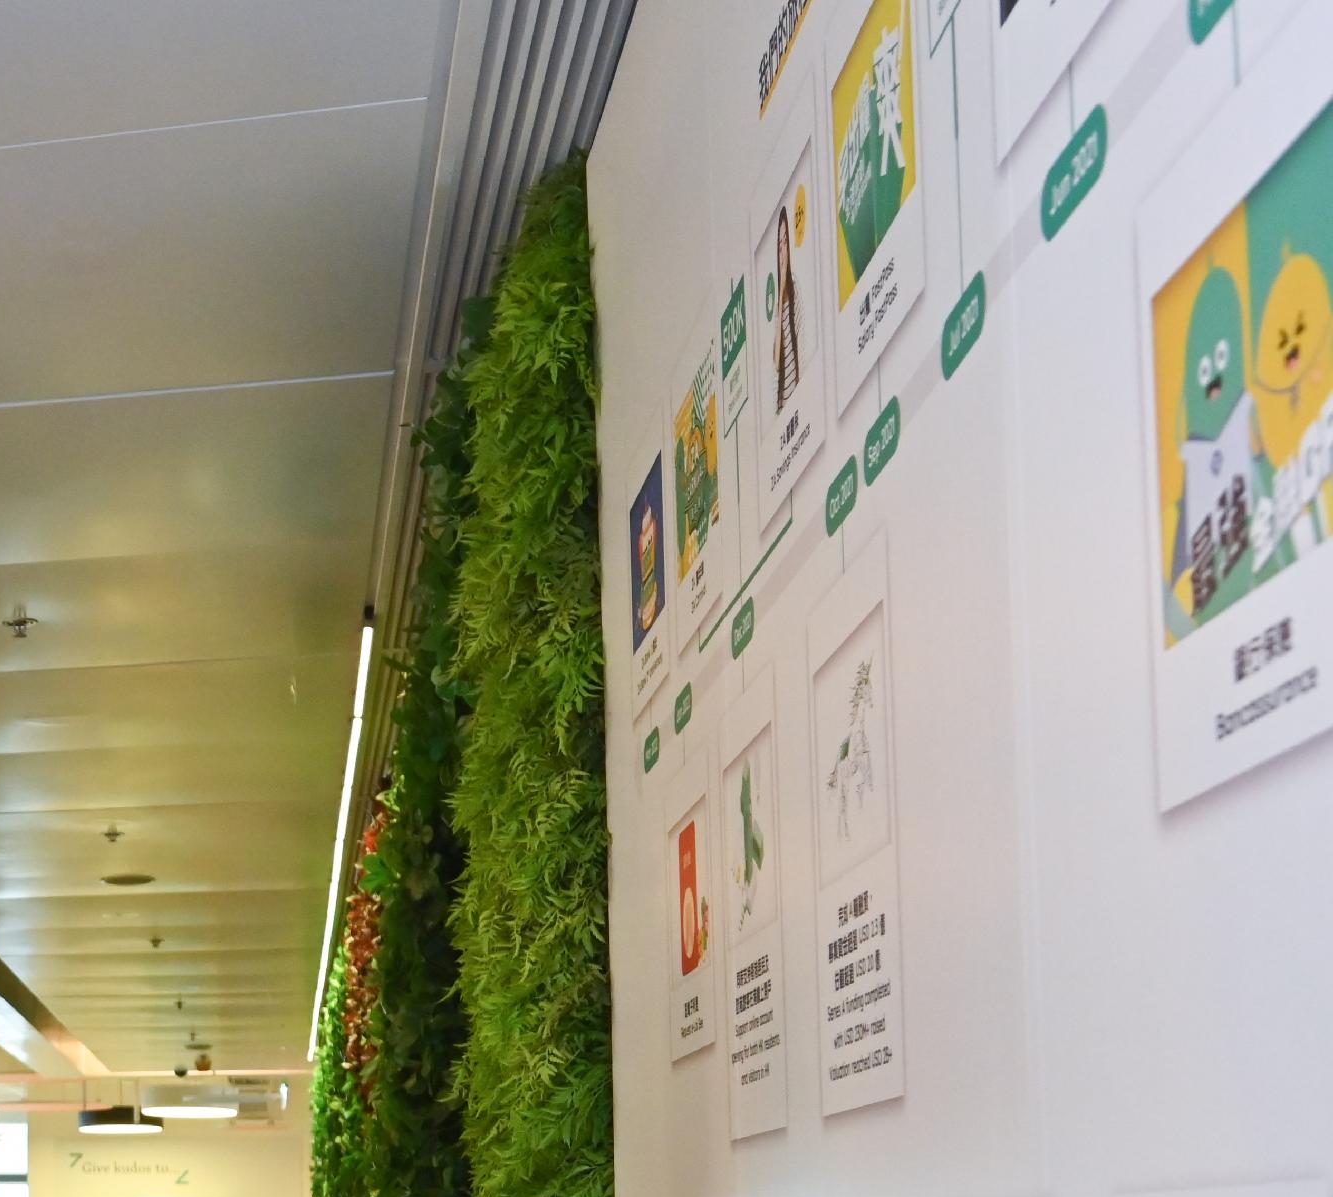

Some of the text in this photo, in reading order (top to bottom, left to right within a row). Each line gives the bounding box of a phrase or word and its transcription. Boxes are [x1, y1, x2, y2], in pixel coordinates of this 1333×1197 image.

[759, 0, 809, 112] 我們的旅
[723, 294, 744, 362] 500K
[865, 981, 891, 1007] completed
[82, 1162, 110, 1173] Give
[114, 1161, 151, 1173] kudos
